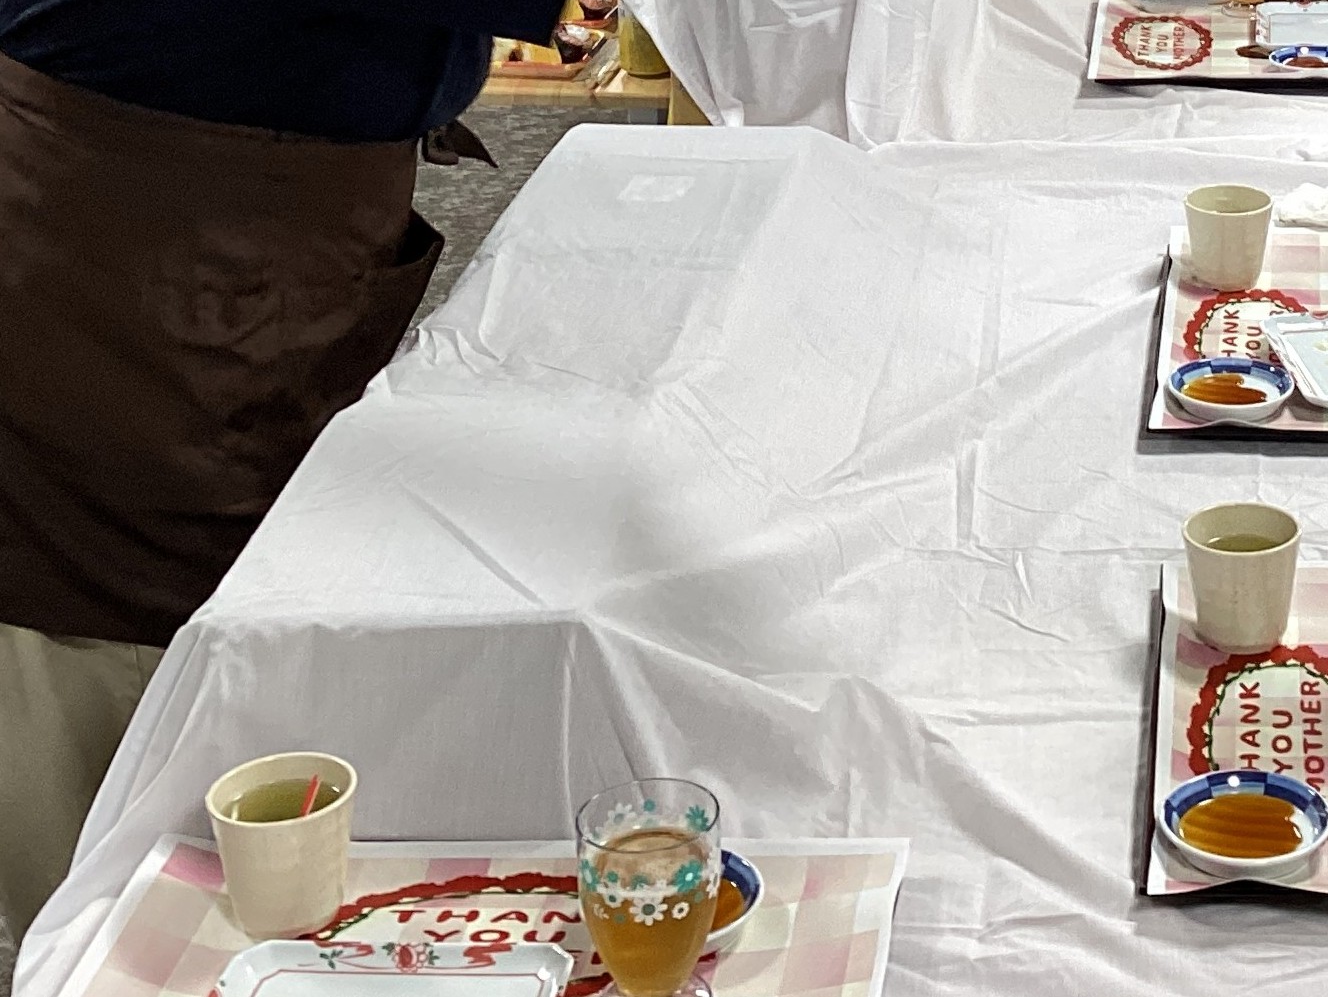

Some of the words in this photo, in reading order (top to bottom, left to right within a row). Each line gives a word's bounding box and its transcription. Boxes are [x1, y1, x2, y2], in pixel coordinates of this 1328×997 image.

[1138, 25, 1152, 57] THANK
[1156, 34, 1169, 53] YOU
[1221, 309, 1240, 357] HANK
[1245, 326, 1263, 359] YOU
[1239, 682, 1261, 771] HANK
[1271, 709, 1293, 773] YOU
[389, 909, 583, 923] THAN
[424, 929, 567, 943] YOU
